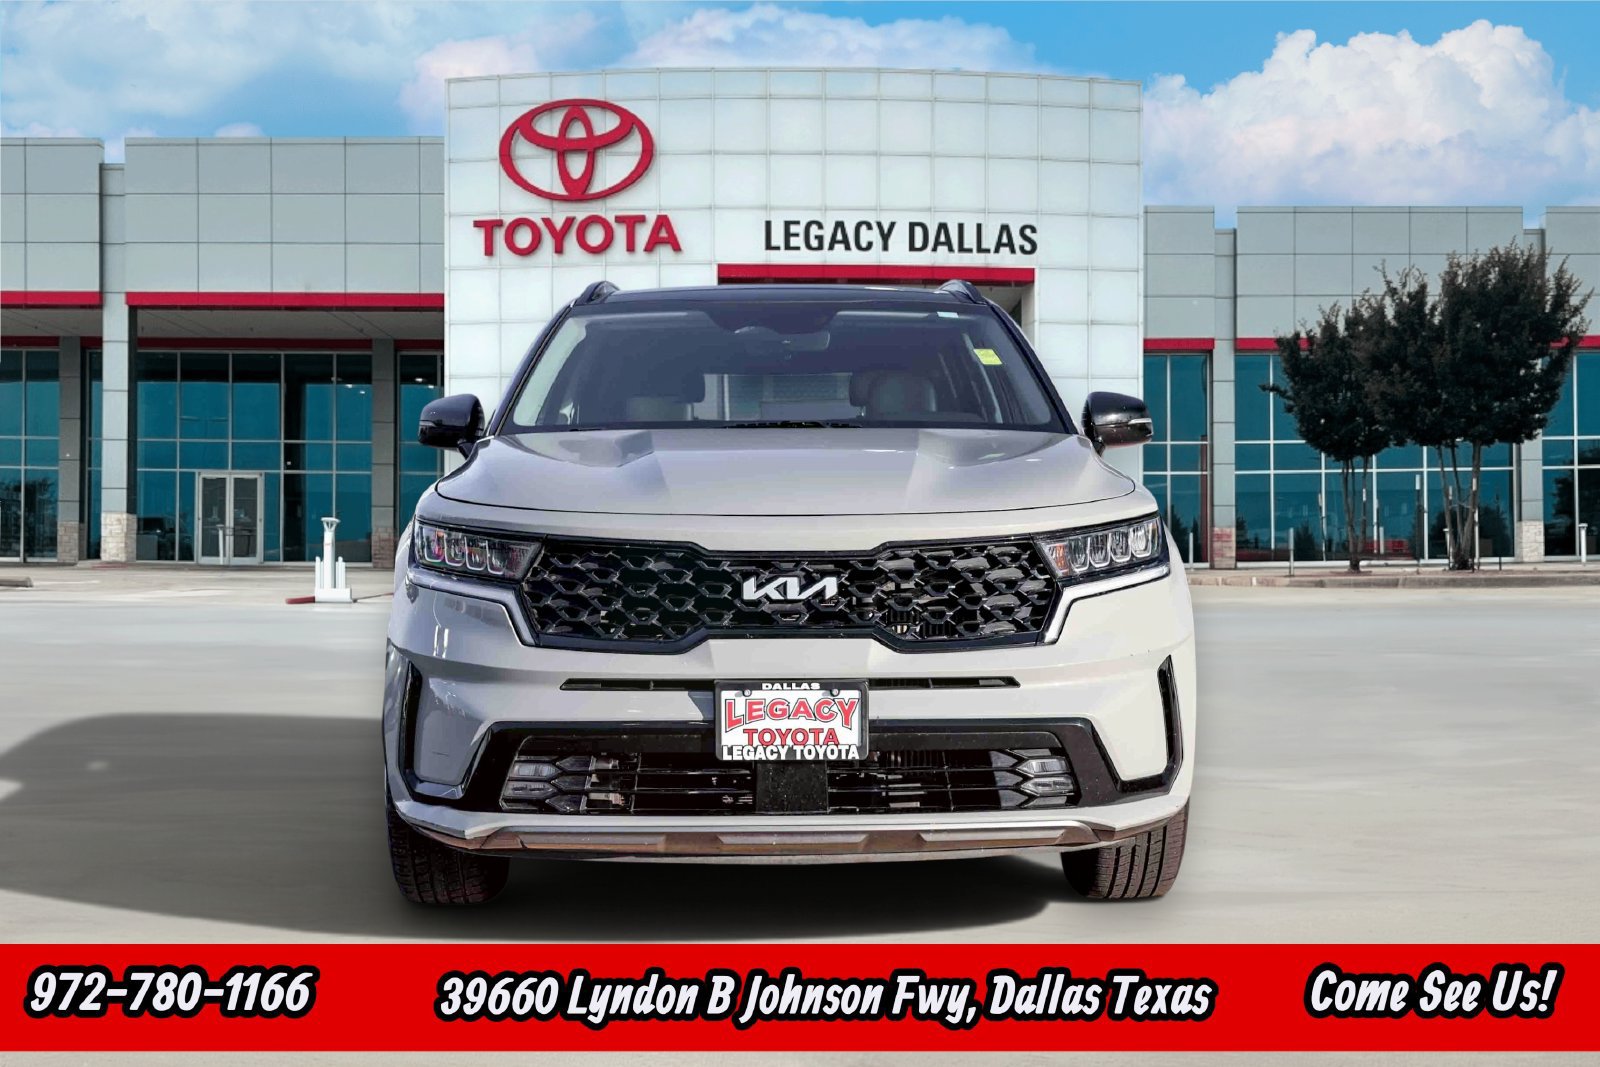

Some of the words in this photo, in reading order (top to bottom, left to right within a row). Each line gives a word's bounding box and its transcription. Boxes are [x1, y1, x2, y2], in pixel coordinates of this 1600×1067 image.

[474, 214, 681, 256] TOYOTA
[765, 220, 896, 252] LEGACY
[908, 221, 1038, 255] DALLAS
[762, 682, 821, 690] DALLAS
[725, 698, 859, 732] LEGACY
[743, 728, 840, 746] TOYOTA
[722, 745, 788, 760] LEGACY
[793, 745, 860, 760] TOYOTA
